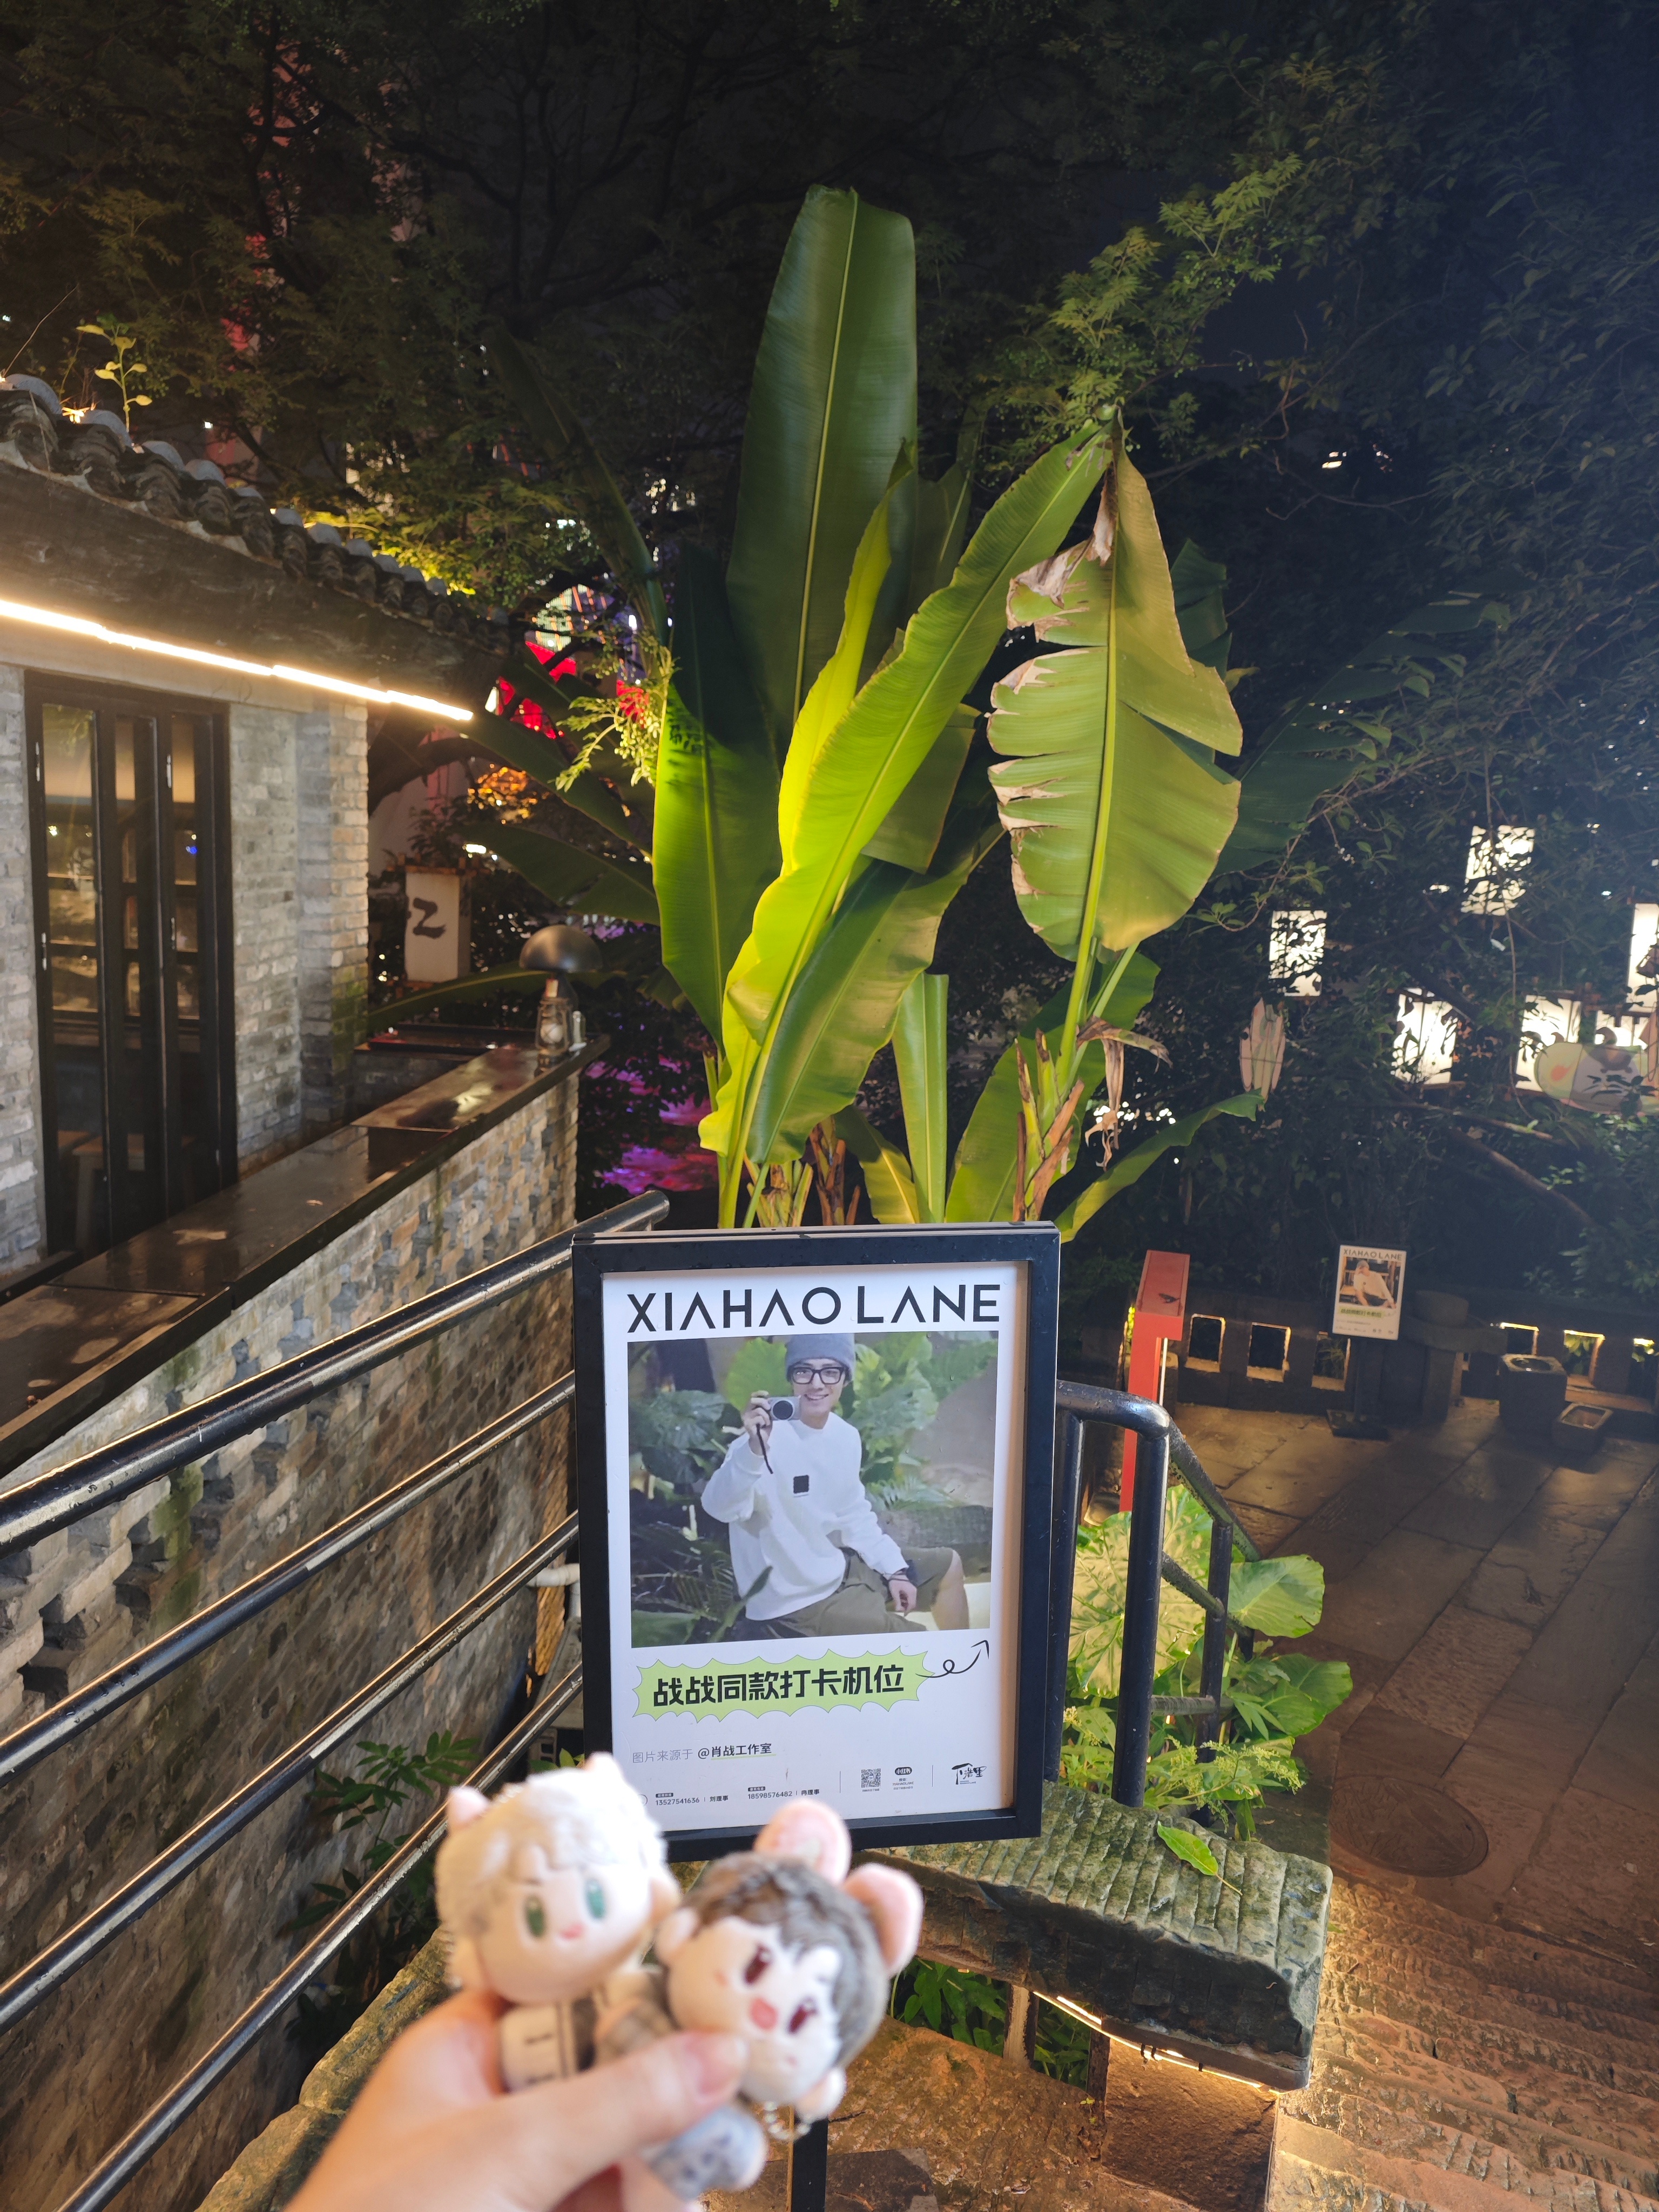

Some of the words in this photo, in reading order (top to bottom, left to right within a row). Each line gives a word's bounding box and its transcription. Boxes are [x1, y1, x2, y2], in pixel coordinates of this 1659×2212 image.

[653, 1664, 904, 1707] 战战同款打卡机位
[632, 1749, 693, 1763] 图片来源于
[698, 1743, 772, 1759] @肖战工作室
[655, 1797, 700, 1806] 13527541636
[747, 1791, 792, 1799] 18598576482
